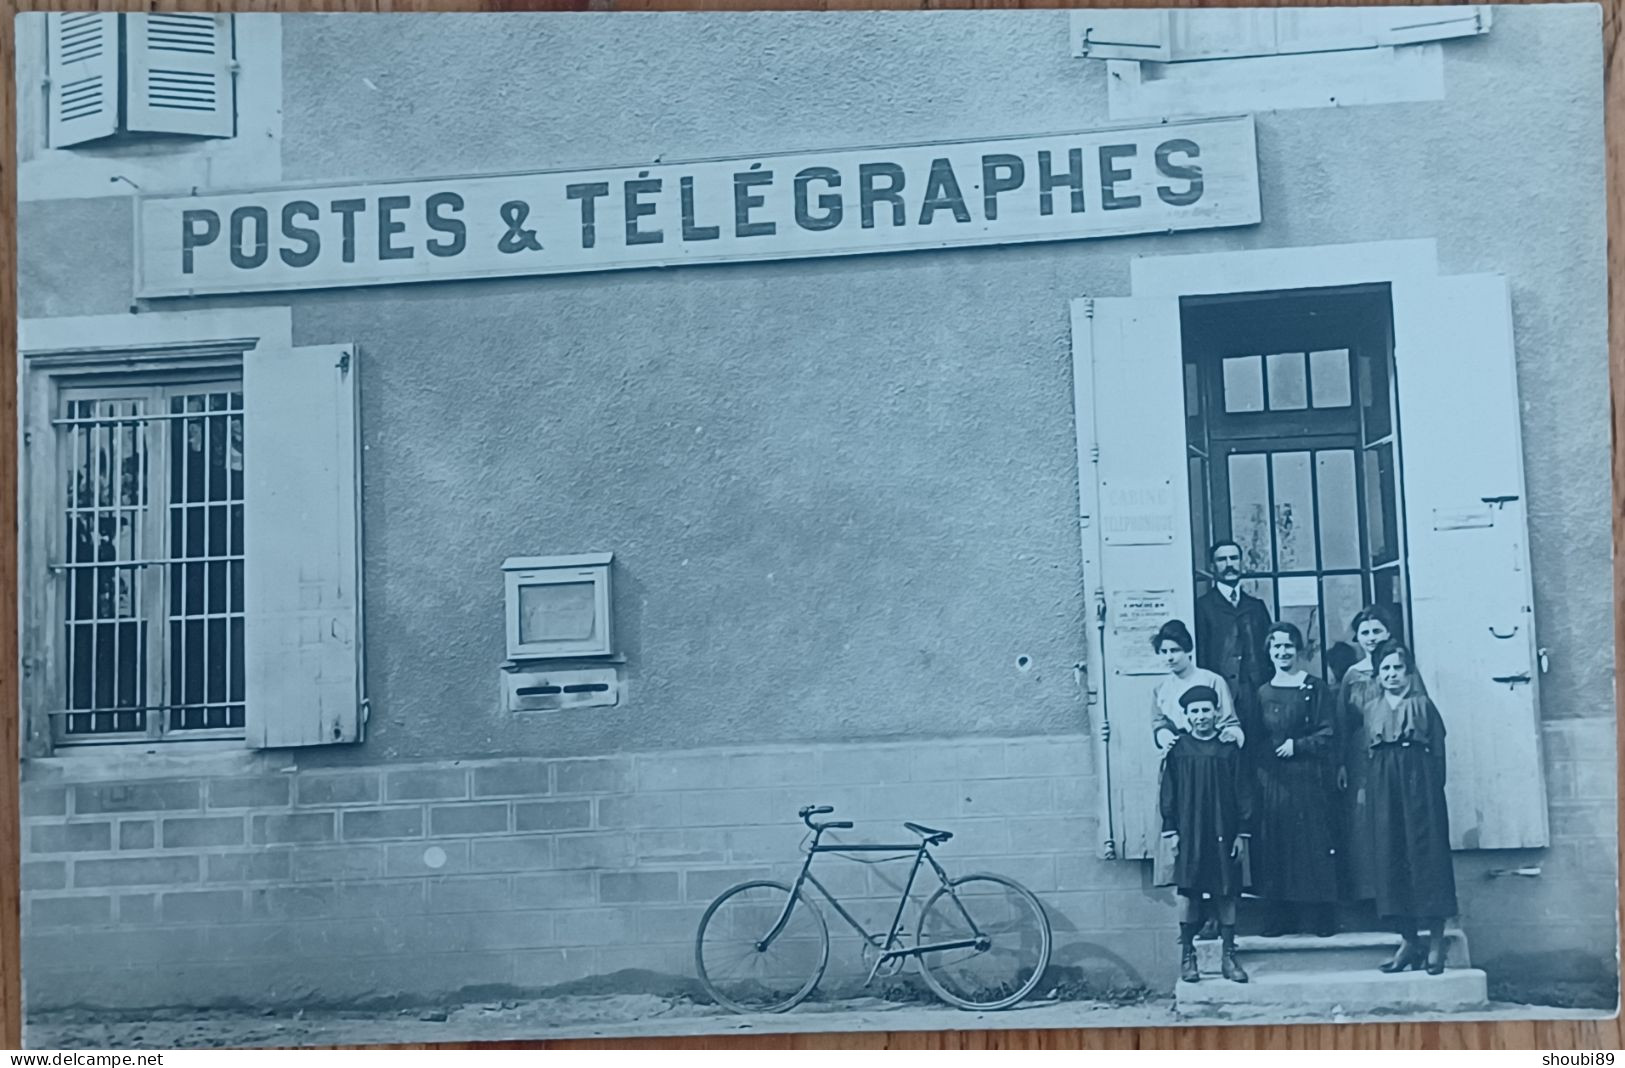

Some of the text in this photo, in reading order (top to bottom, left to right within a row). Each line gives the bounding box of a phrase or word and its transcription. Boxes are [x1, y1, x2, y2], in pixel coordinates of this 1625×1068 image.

[182, 138, 1205, 274] POSTES & TÉLÉGRAPHES
